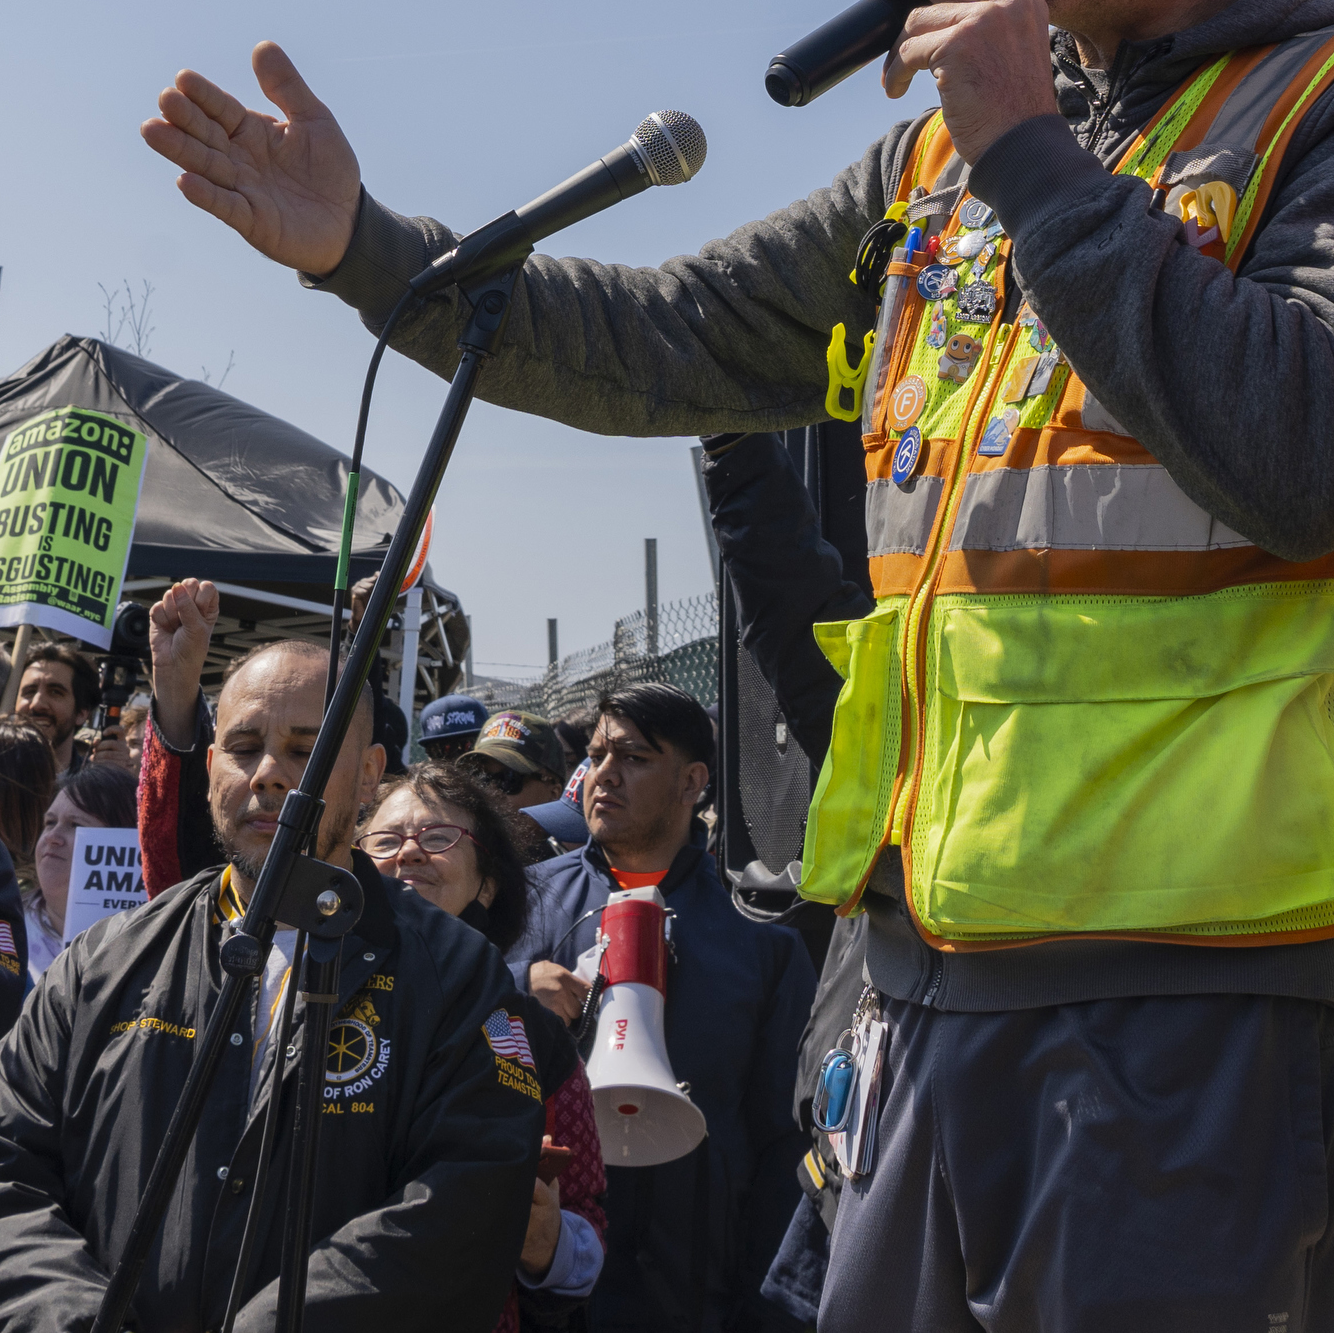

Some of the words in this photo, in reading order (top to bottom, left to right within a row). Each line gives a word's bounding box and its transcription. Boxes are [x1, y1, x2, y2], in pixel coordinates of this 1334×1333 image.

[629, 149, 646, 174] SHURE
[8, 418, 130, 456] amazon:
[0, 447, 119, 505] UNION
[38, 535, 53, 552] IS
[2, 583, 59, 595] Assembly
[84, 845, 142, 867] UNI
[84, 870, 147, 893] AMA
[110, 1021, 136, 1035] SHOP
[139, 1018, 196, 1039] STEWARD
[324, 1087, 341, 1099] OF
[344, 1076, 373, 1098] RON
[371, 1038, 391, 1079] CAREY
[495, 1055, 524, 1080] PROUD
[351, 1102, 374, 1113] 804
